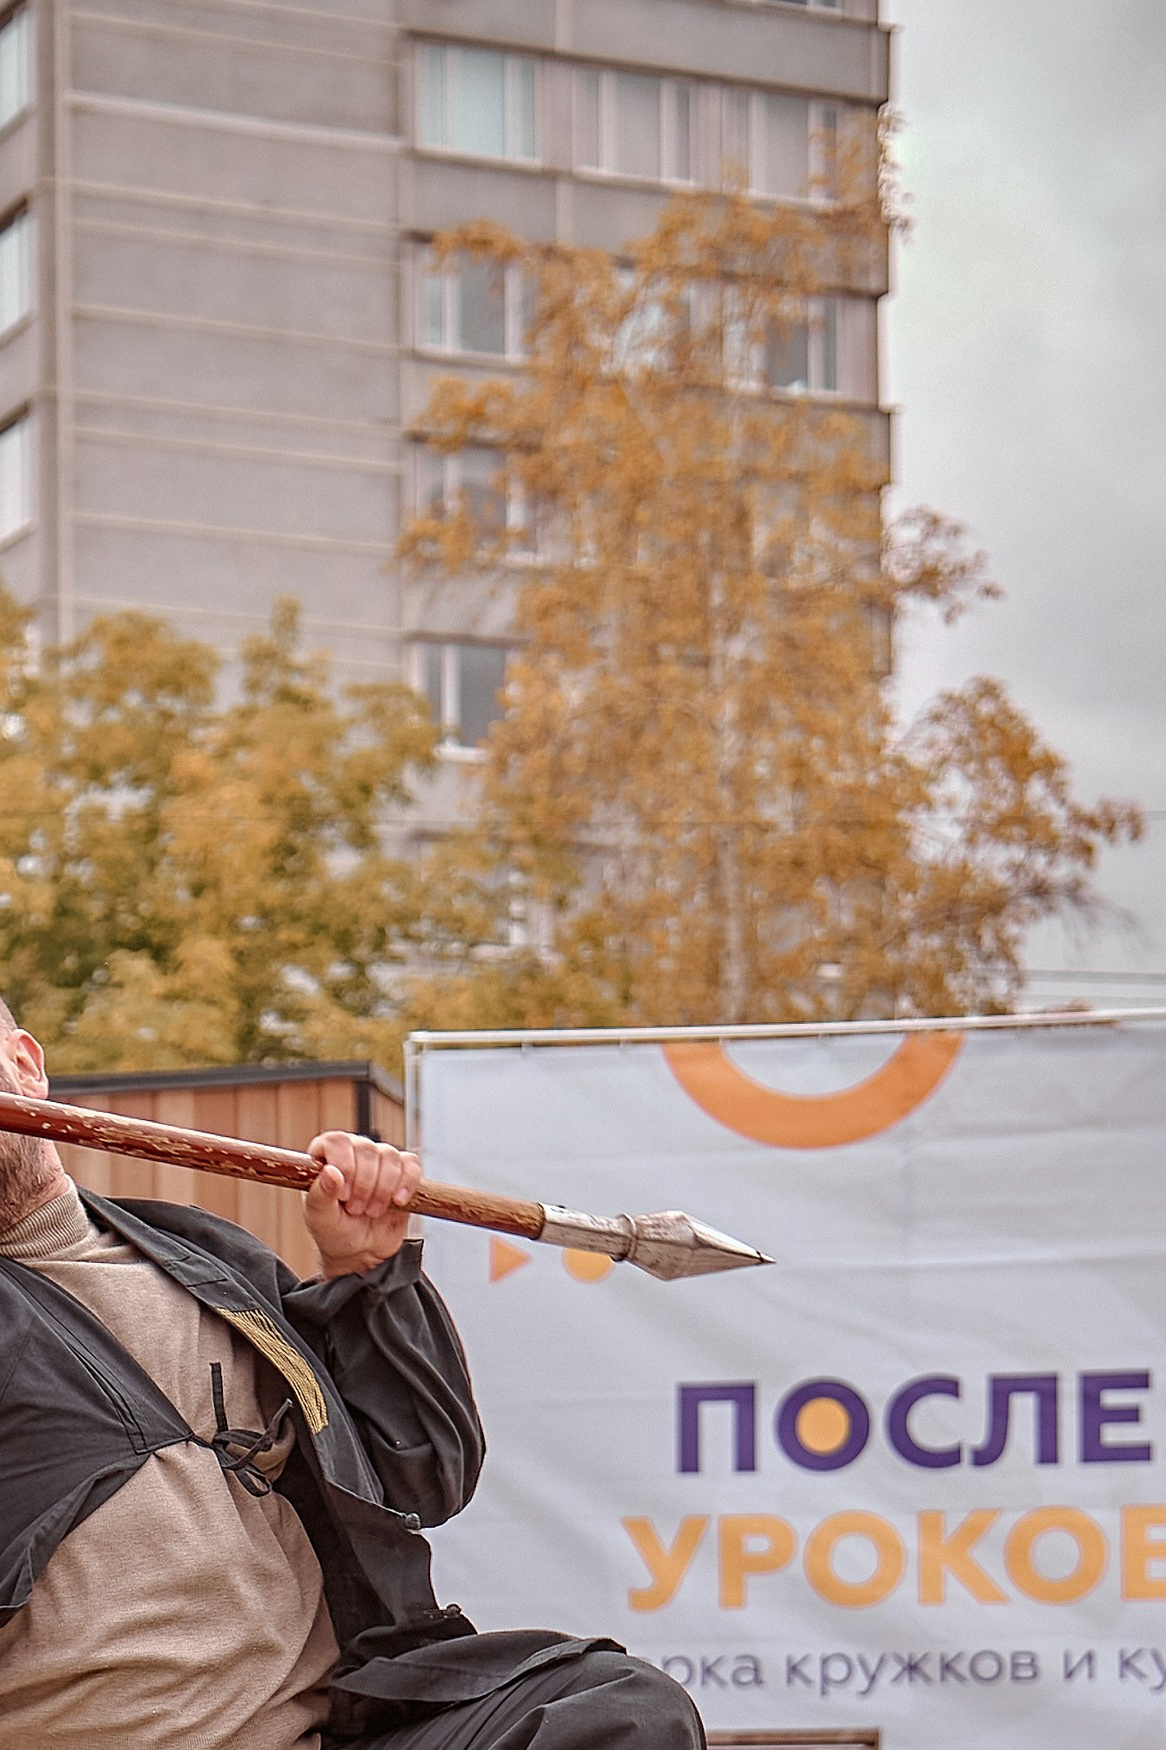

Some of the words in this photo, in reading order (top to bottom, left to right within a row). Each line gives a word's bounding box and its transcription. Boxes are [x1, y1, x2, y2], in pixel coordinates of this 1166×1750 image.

[676, 1369, 1152, 1473] ПОСЛЕ
[786, 1649, 1038, 1697] кружков
[1063, 1649, 1094, 1680] и
